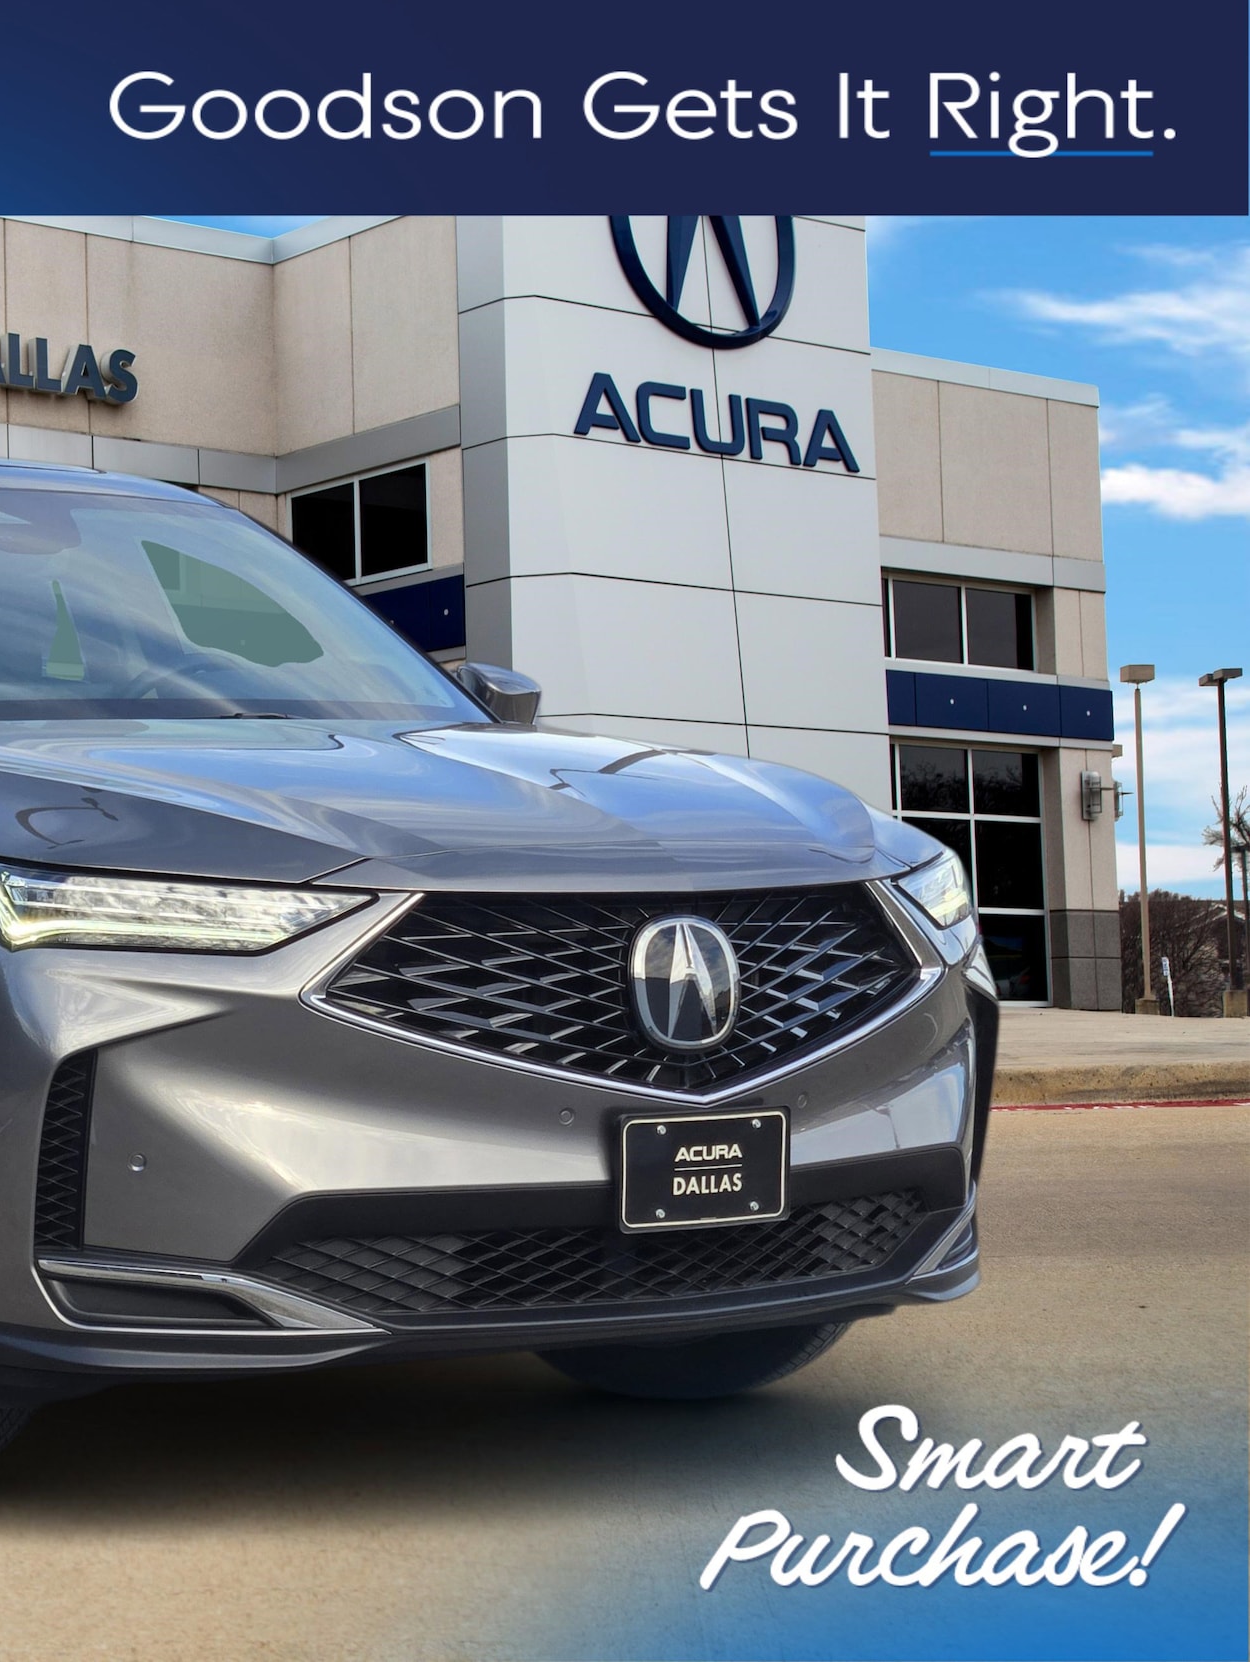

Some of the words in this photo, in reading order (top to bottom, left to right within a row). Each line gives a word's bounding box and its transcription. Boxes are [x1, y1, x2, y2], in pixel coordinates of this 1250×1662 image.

[573, 371, 860, 473] ACURA
[673, 1143, 744, 1163] ACURA
[672, 1172, 743, 1197] DALLAS
